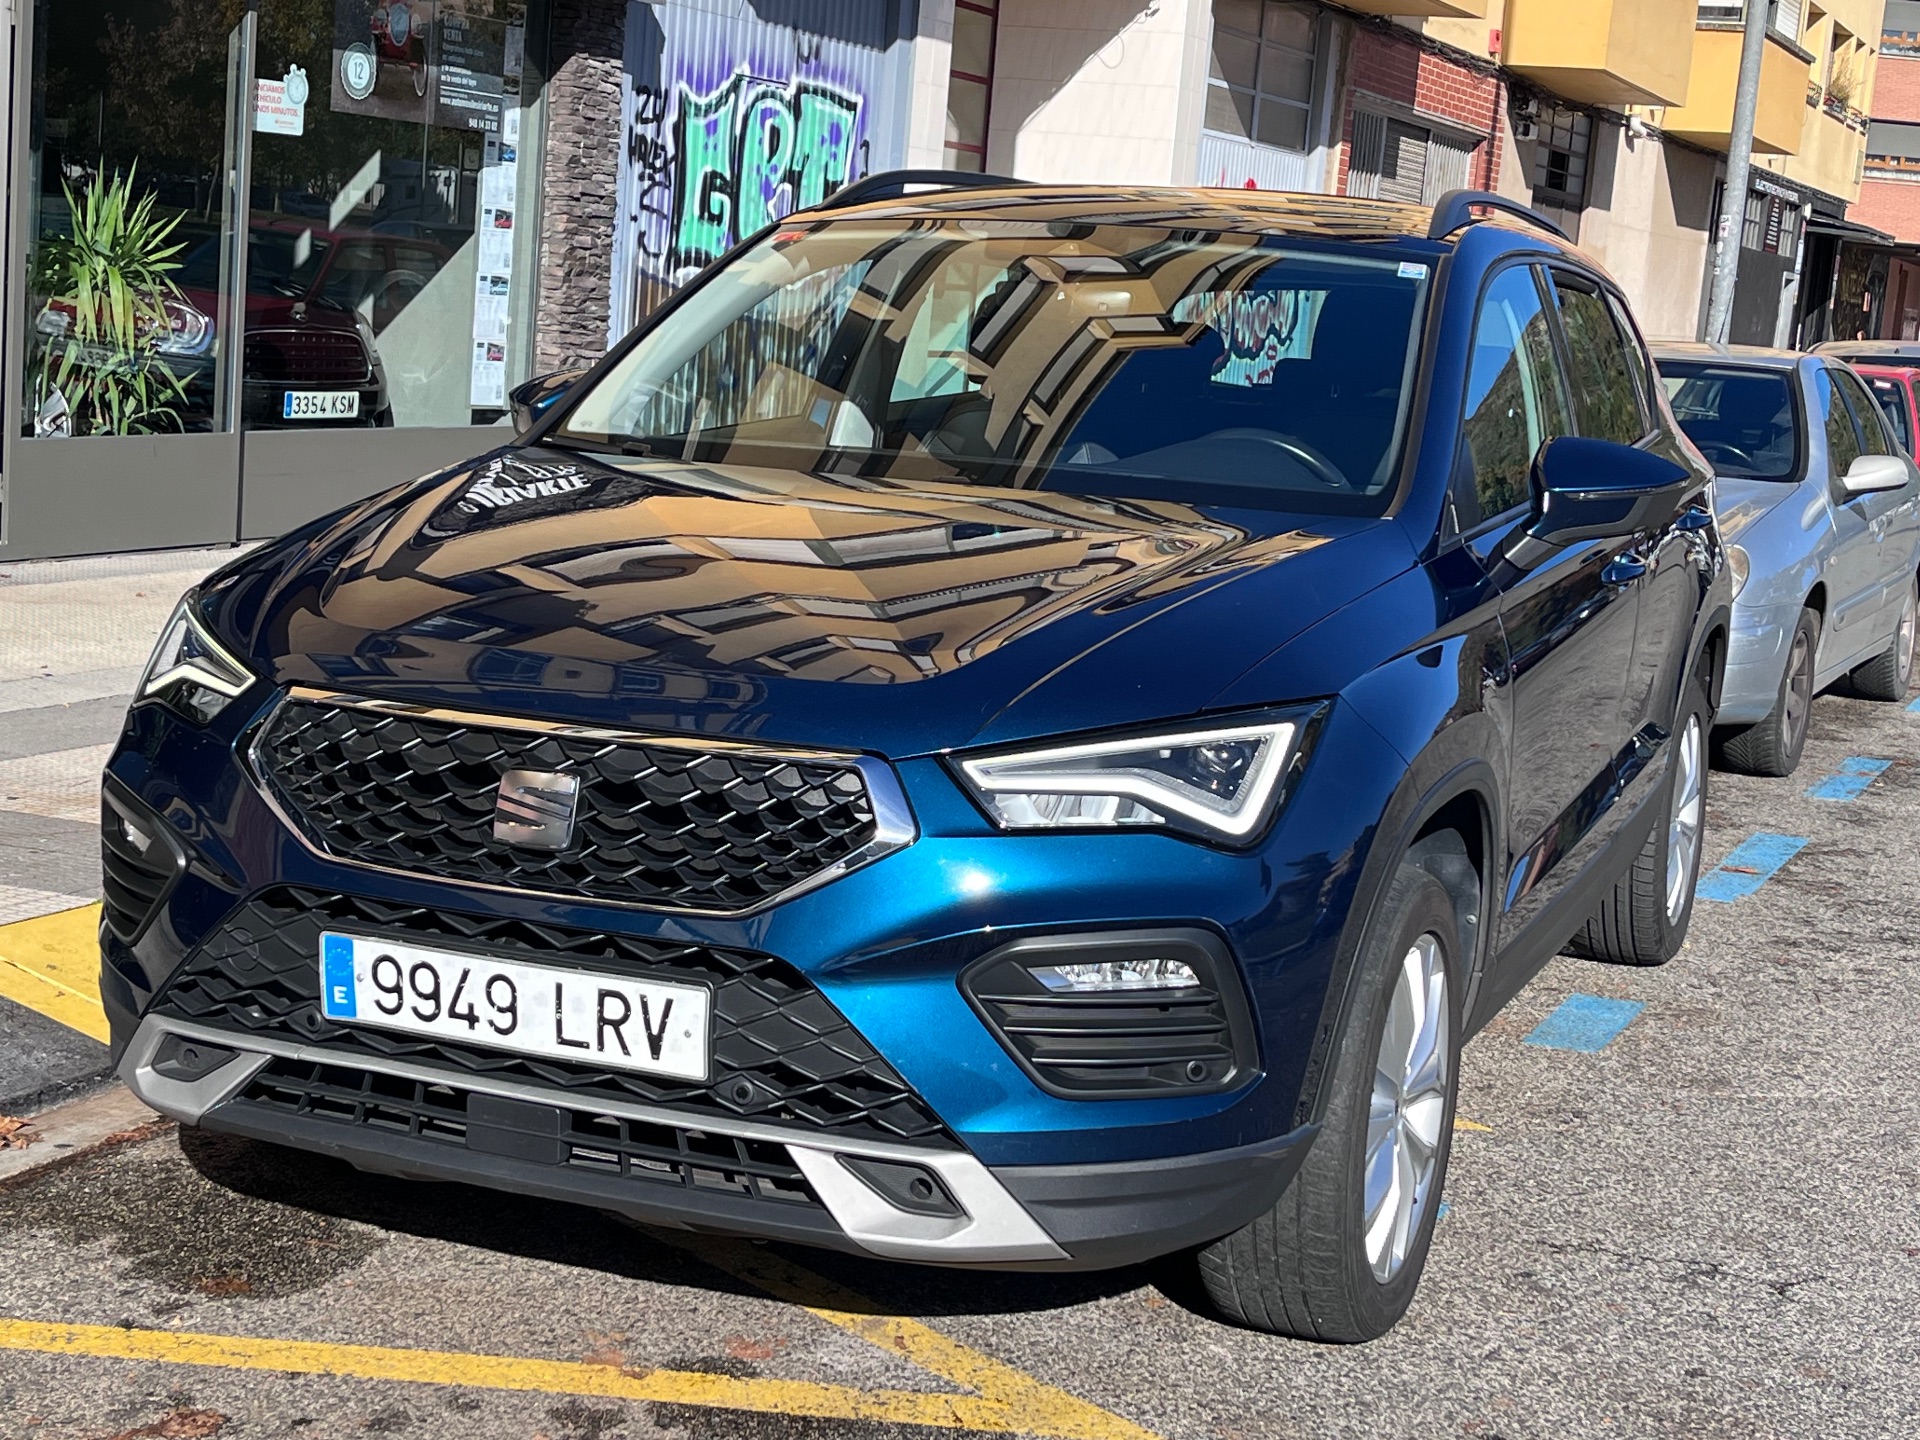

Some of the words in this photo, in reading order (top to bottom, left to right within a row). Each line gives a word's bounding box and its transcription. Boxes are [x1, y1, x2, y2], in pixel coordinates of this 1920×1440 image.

[353, 61, 364, 80] 12
[293, 395, 327, 415] 3354
[331, 395, 355, 414] KSM
[333, 985, 349, 1004] E
[371, 953, 518, 1036] 9949
[554, 982, 674, 1061] LRV
